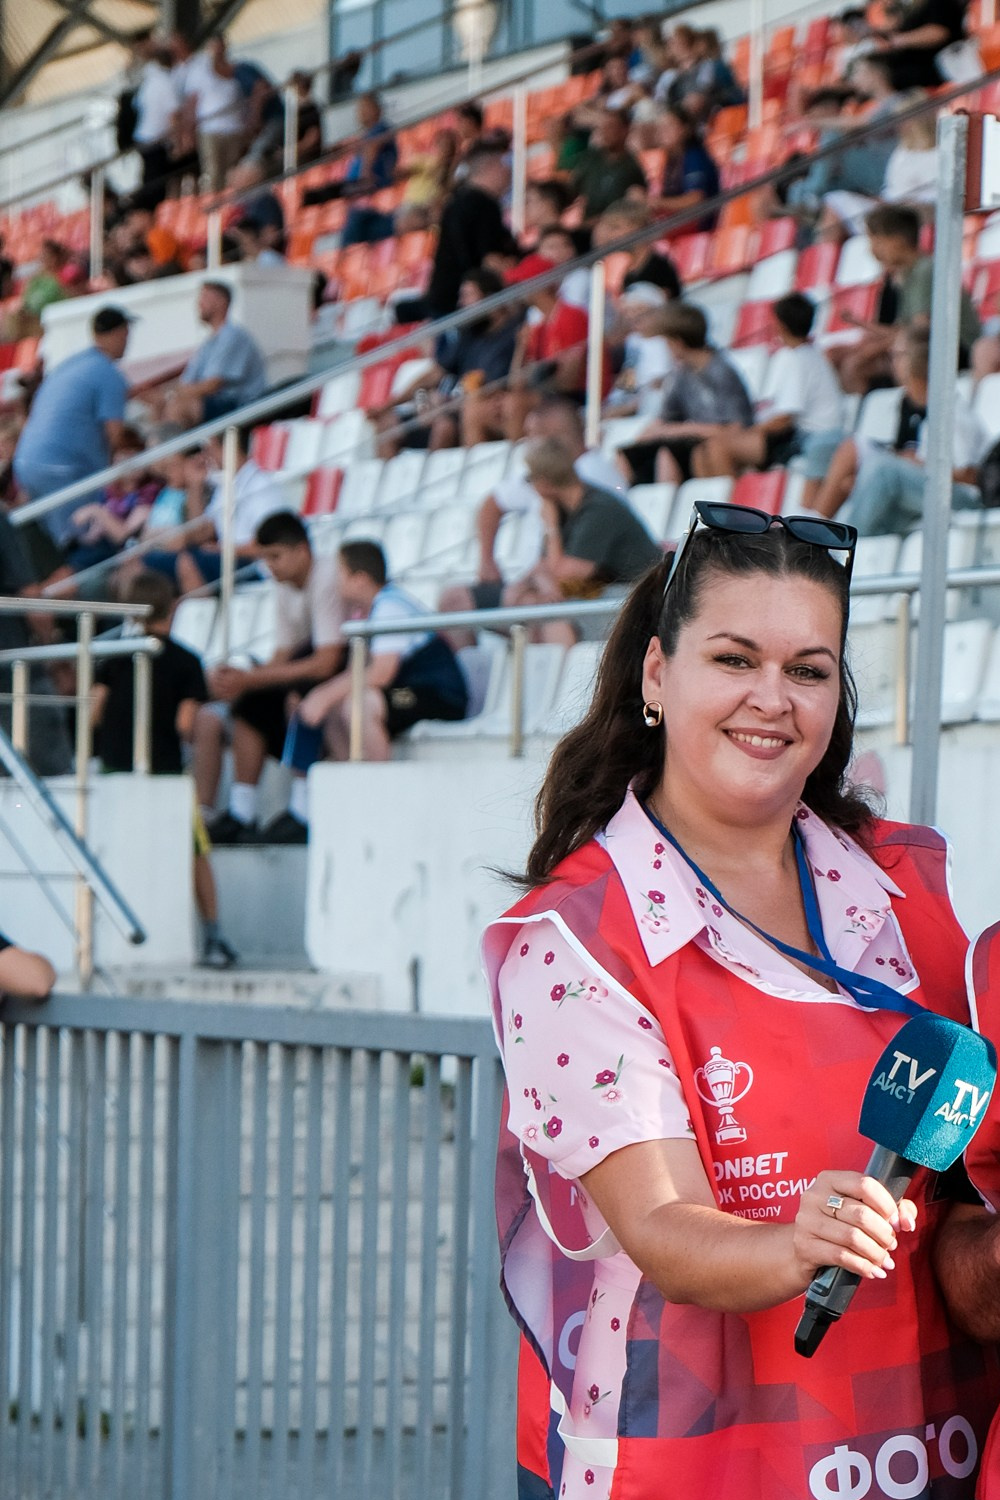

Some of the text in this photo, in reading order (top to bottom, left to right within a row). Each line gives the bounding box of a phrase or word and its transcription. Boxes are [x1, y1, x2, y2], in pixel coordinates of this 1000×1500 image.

[893, 1050, 937, 1091] TV
[954, 1079, 990, 1118] TV
[713, 1152, 788, 1182] ONBET
